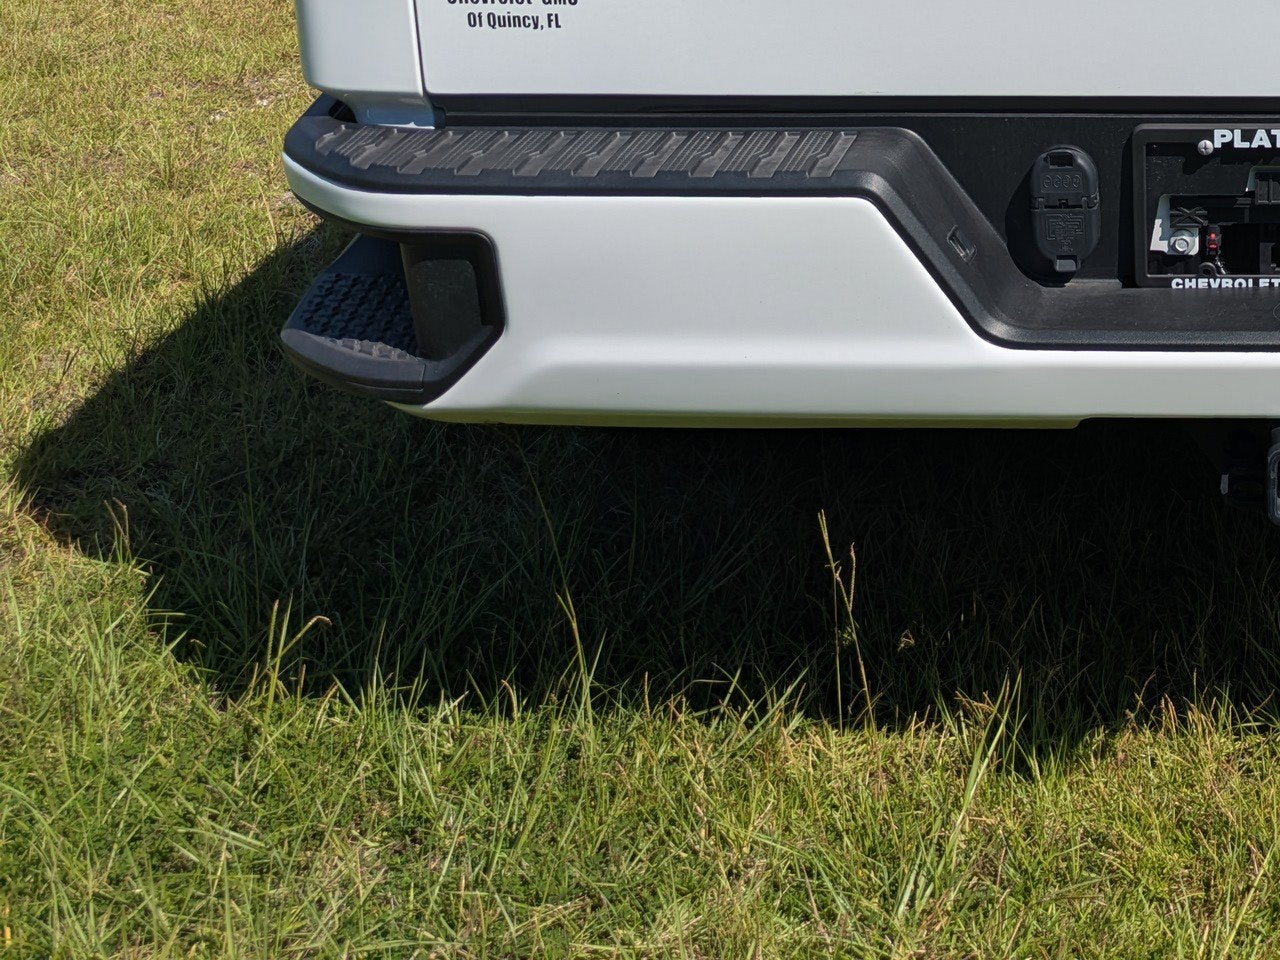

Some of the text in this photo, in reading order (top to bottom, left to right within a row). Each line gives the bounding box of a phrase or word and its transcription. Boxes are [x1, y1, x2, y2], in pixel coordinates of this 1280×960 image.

[467, 11, 562, 31] Of Quincy, FL
